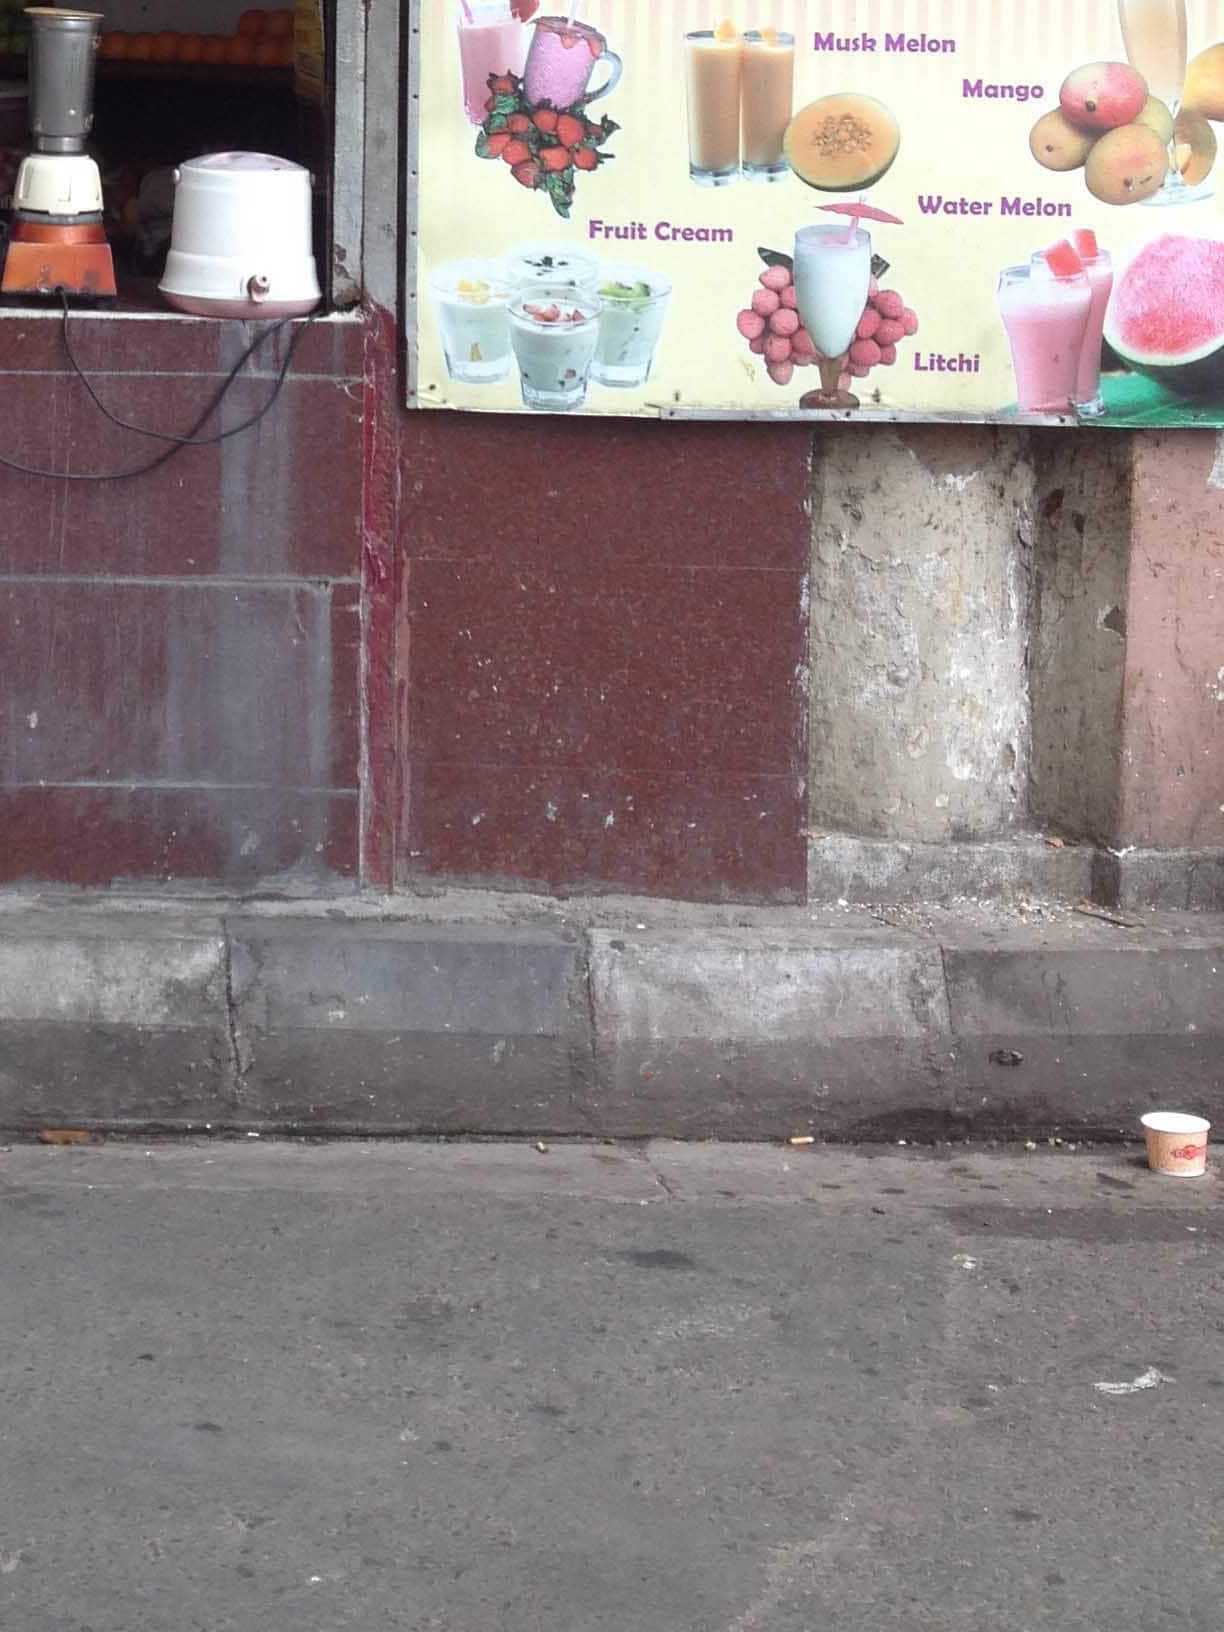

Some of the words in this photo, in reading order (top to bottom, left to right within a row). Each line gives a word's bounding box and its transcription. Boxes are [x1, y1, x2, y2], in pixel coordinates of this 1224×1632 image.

[815, 32, 876, 51] Musk
[885, 33, 955, 52] Melon
[963, 79, 1043, 101] Mango
[918, 196, 992, 215] Water
[1001, 197, 1071, 216] Melon
[589, 220, 647, 240] Fruit
[655, 222, 732, 241] Cream
[915, 352, 979, 372] Litchi
